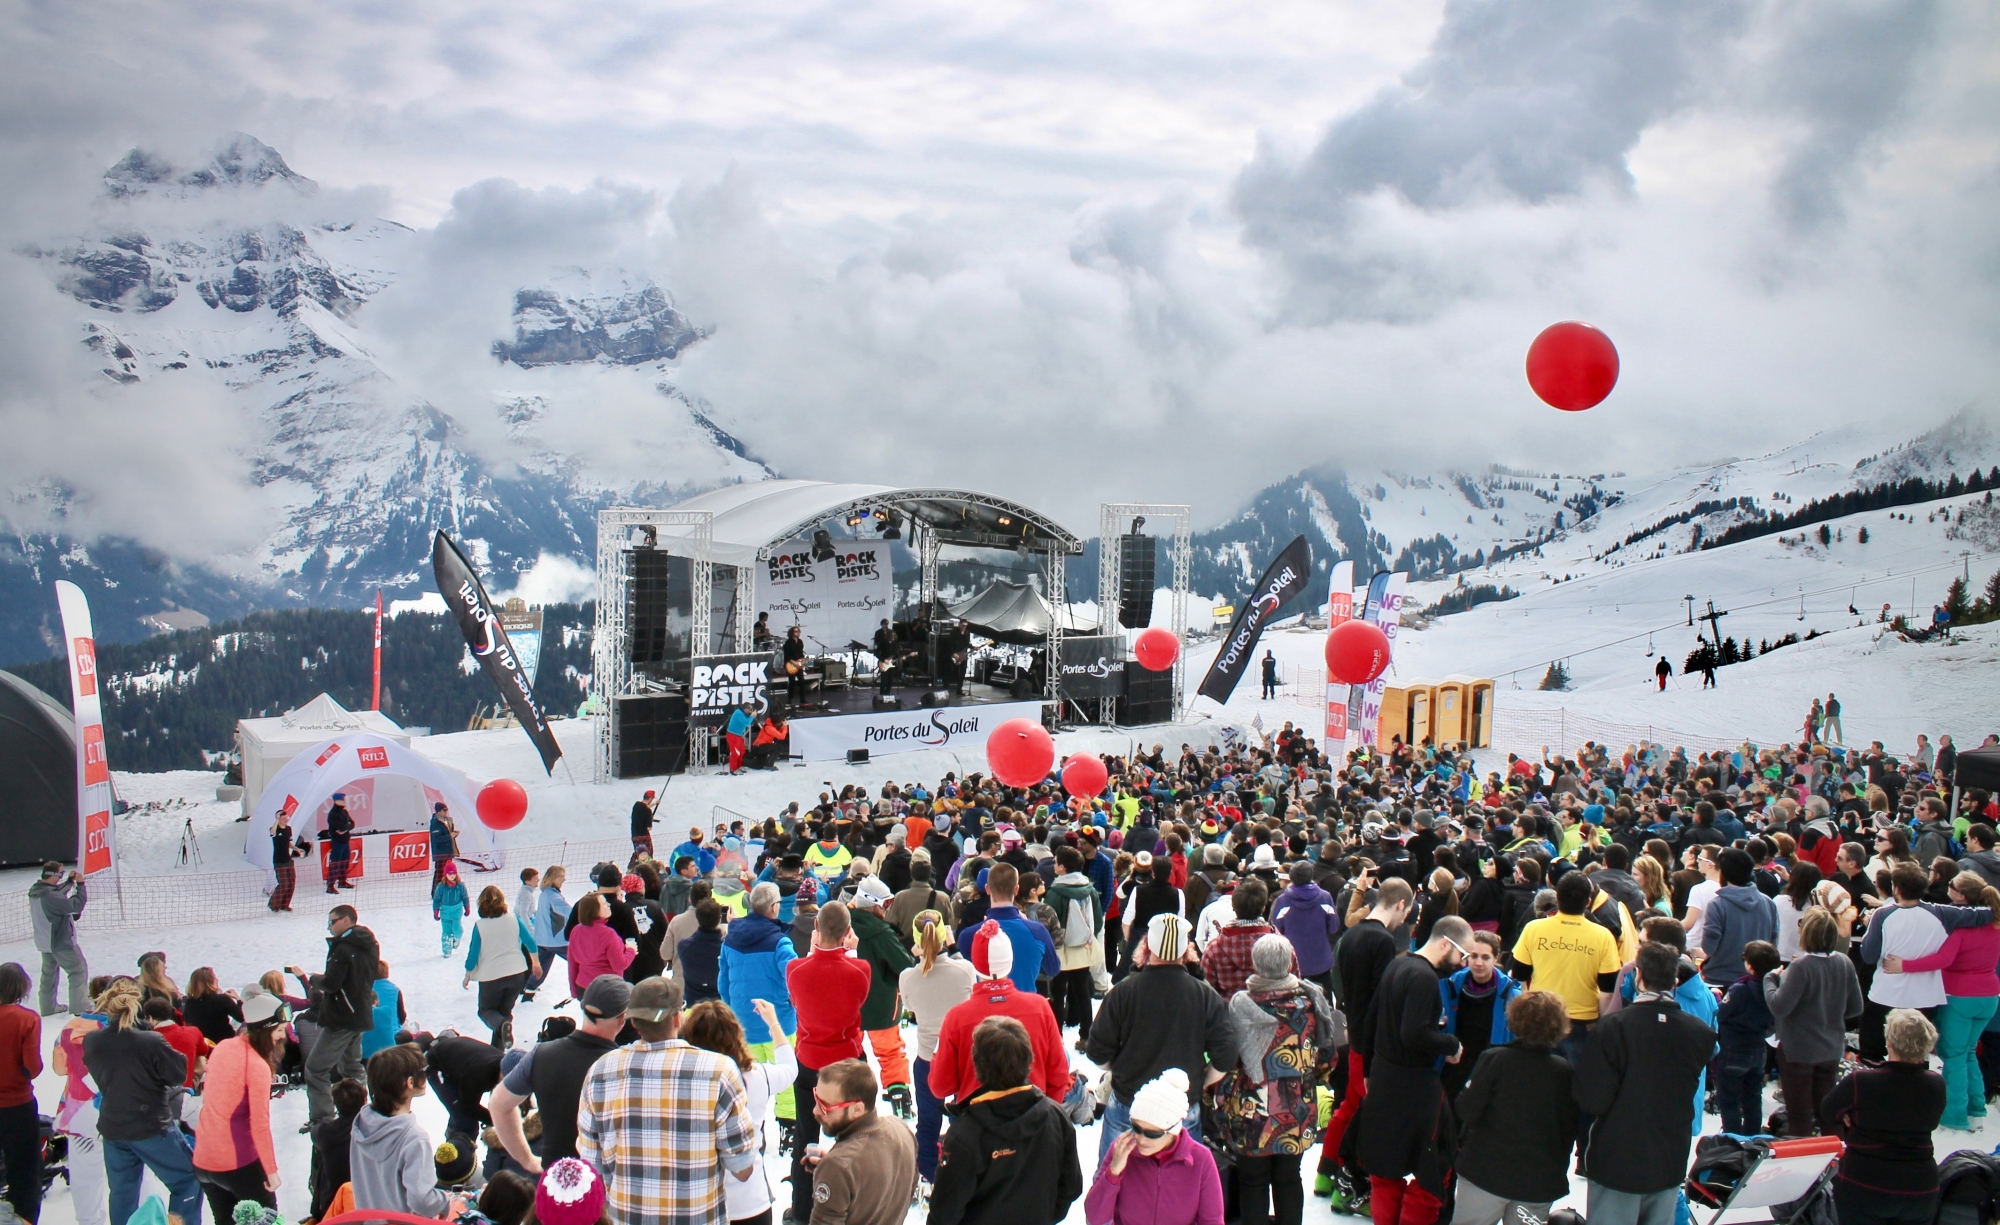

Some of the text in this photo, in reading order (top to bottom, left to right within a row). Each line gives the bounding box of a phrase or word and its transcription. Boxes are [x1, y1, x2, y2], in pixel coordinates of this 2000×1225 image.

[768, 552, 812, 569] ROCK
[835, 550, 877, 567] ROCK
[769, 566, 816, 583] PISTES
[837, 564, 880, 581] PISTES
[1251, 566, 1297, 619] Soleil
[1380, 593, 1402, 611] W9
[769, 597, 821, 614] Portes du Soleil
[861, 595, 886, 611] Soleil
[458, 579, 496, 656] Soleil
[1246, 609, 1261, 631] du
[495, 643, 517, 671] du
[1216, 628, 1251, 674] Portes
[692, 661, 769, 688] ROCK
[1061, 656, 1125, 678] Portes du Soleil
[691, 685, 769, 715] PISTES
[691, 708, 724, 716] FESTIVAL
[864, 709, 979, 746] Portes du Soleil
[362, 751, 385, 762] RTL2
[393, 842, 427, 860] RTL2
[1537, 936, 1595, 956] Rebelote
